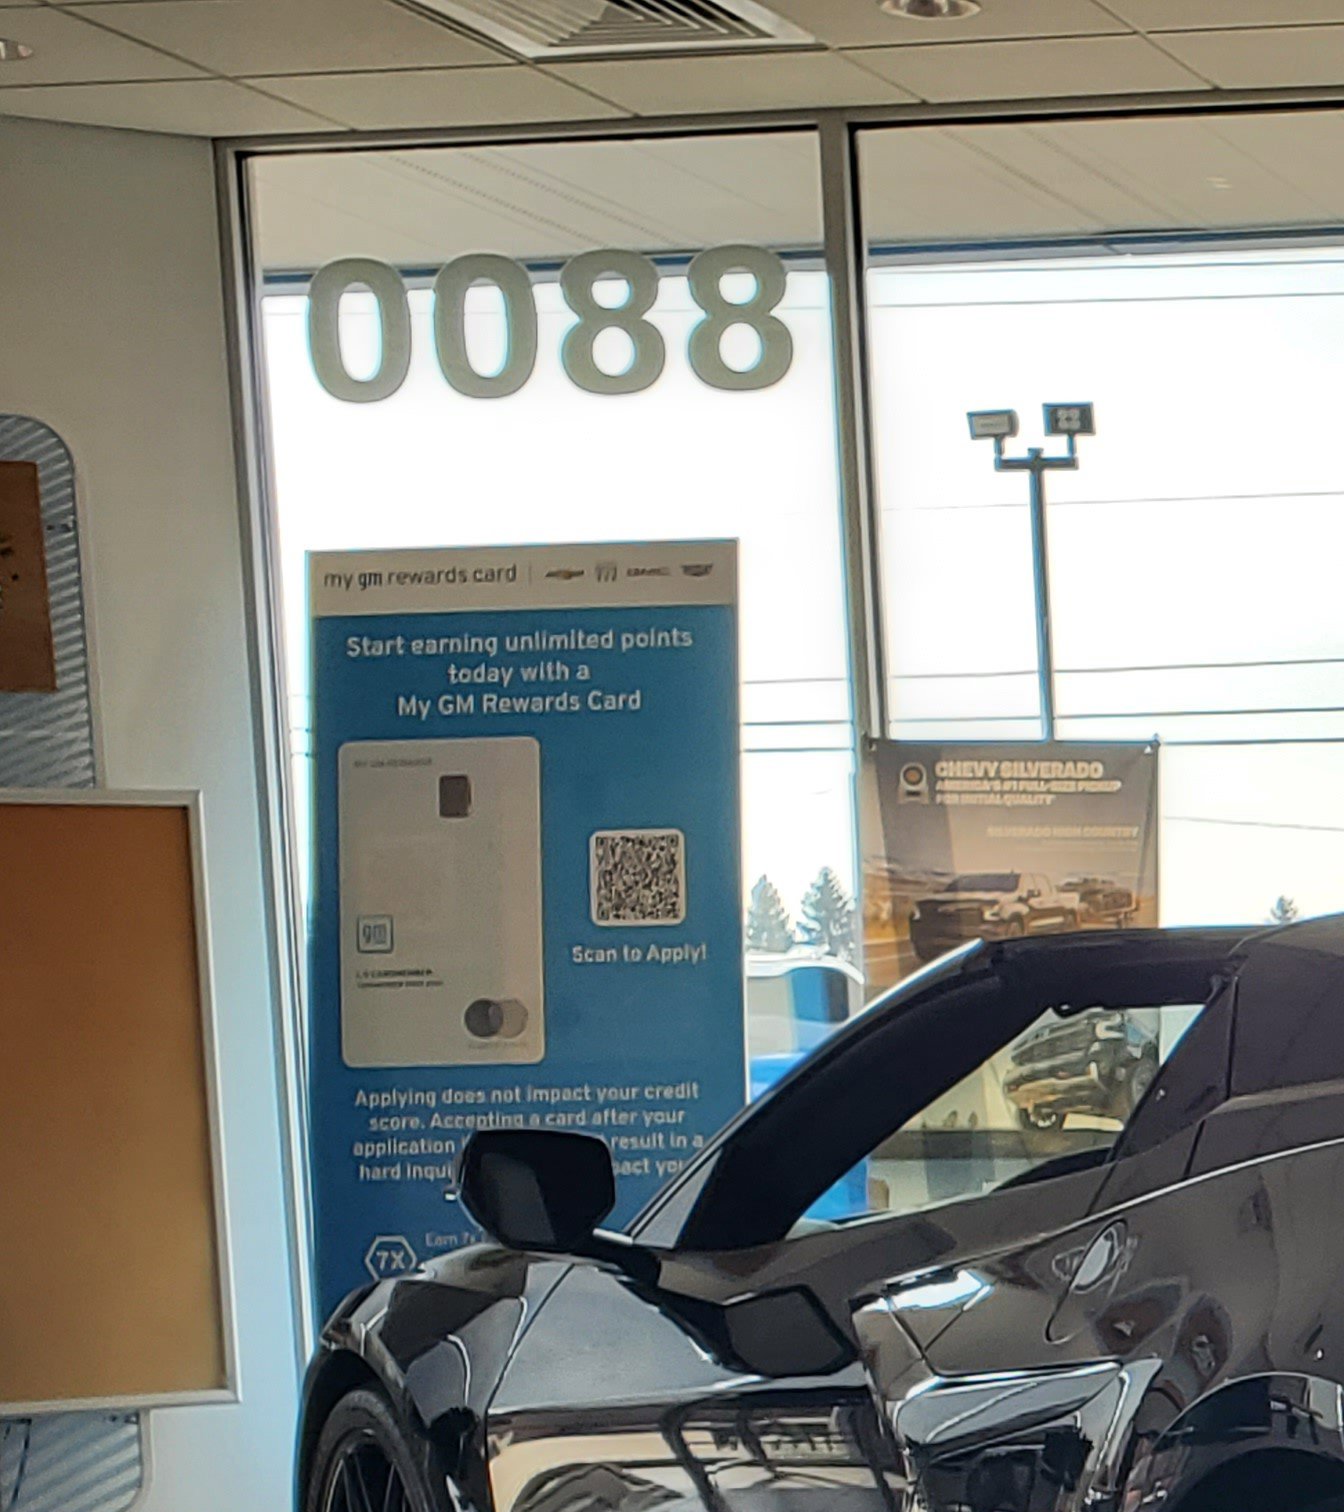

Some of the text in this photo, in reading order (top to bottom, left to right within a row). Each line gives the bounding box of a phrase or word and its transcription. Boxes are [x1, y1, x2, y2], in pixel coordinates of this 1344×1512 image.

[324, 563, 516, 590] my gm rewards card
[346, 627, 693, 657] Start earning unlimited points
[447, 661, 590, 687] today with a
[398, 689, 641, 721] My GM Rewards Card
[934, 760, 1104, 779] CHEVY SILVERADO
[572, 942, 707, 965] Scan to Apply!
[354, 1081, 699, 1111] Applying does not impact your credit
[369, 1108, 685, 1131] score. Accepting a card after your
[353, 1137, 455, 1160] application
[610, 1133, 664, 1150] result
[670, 1133, 687, 1149] in
[692, 1136, 704, 1149] a
[359, 1162, 401, 1181] hard
[376, 1250, 406, 1271] 7X
